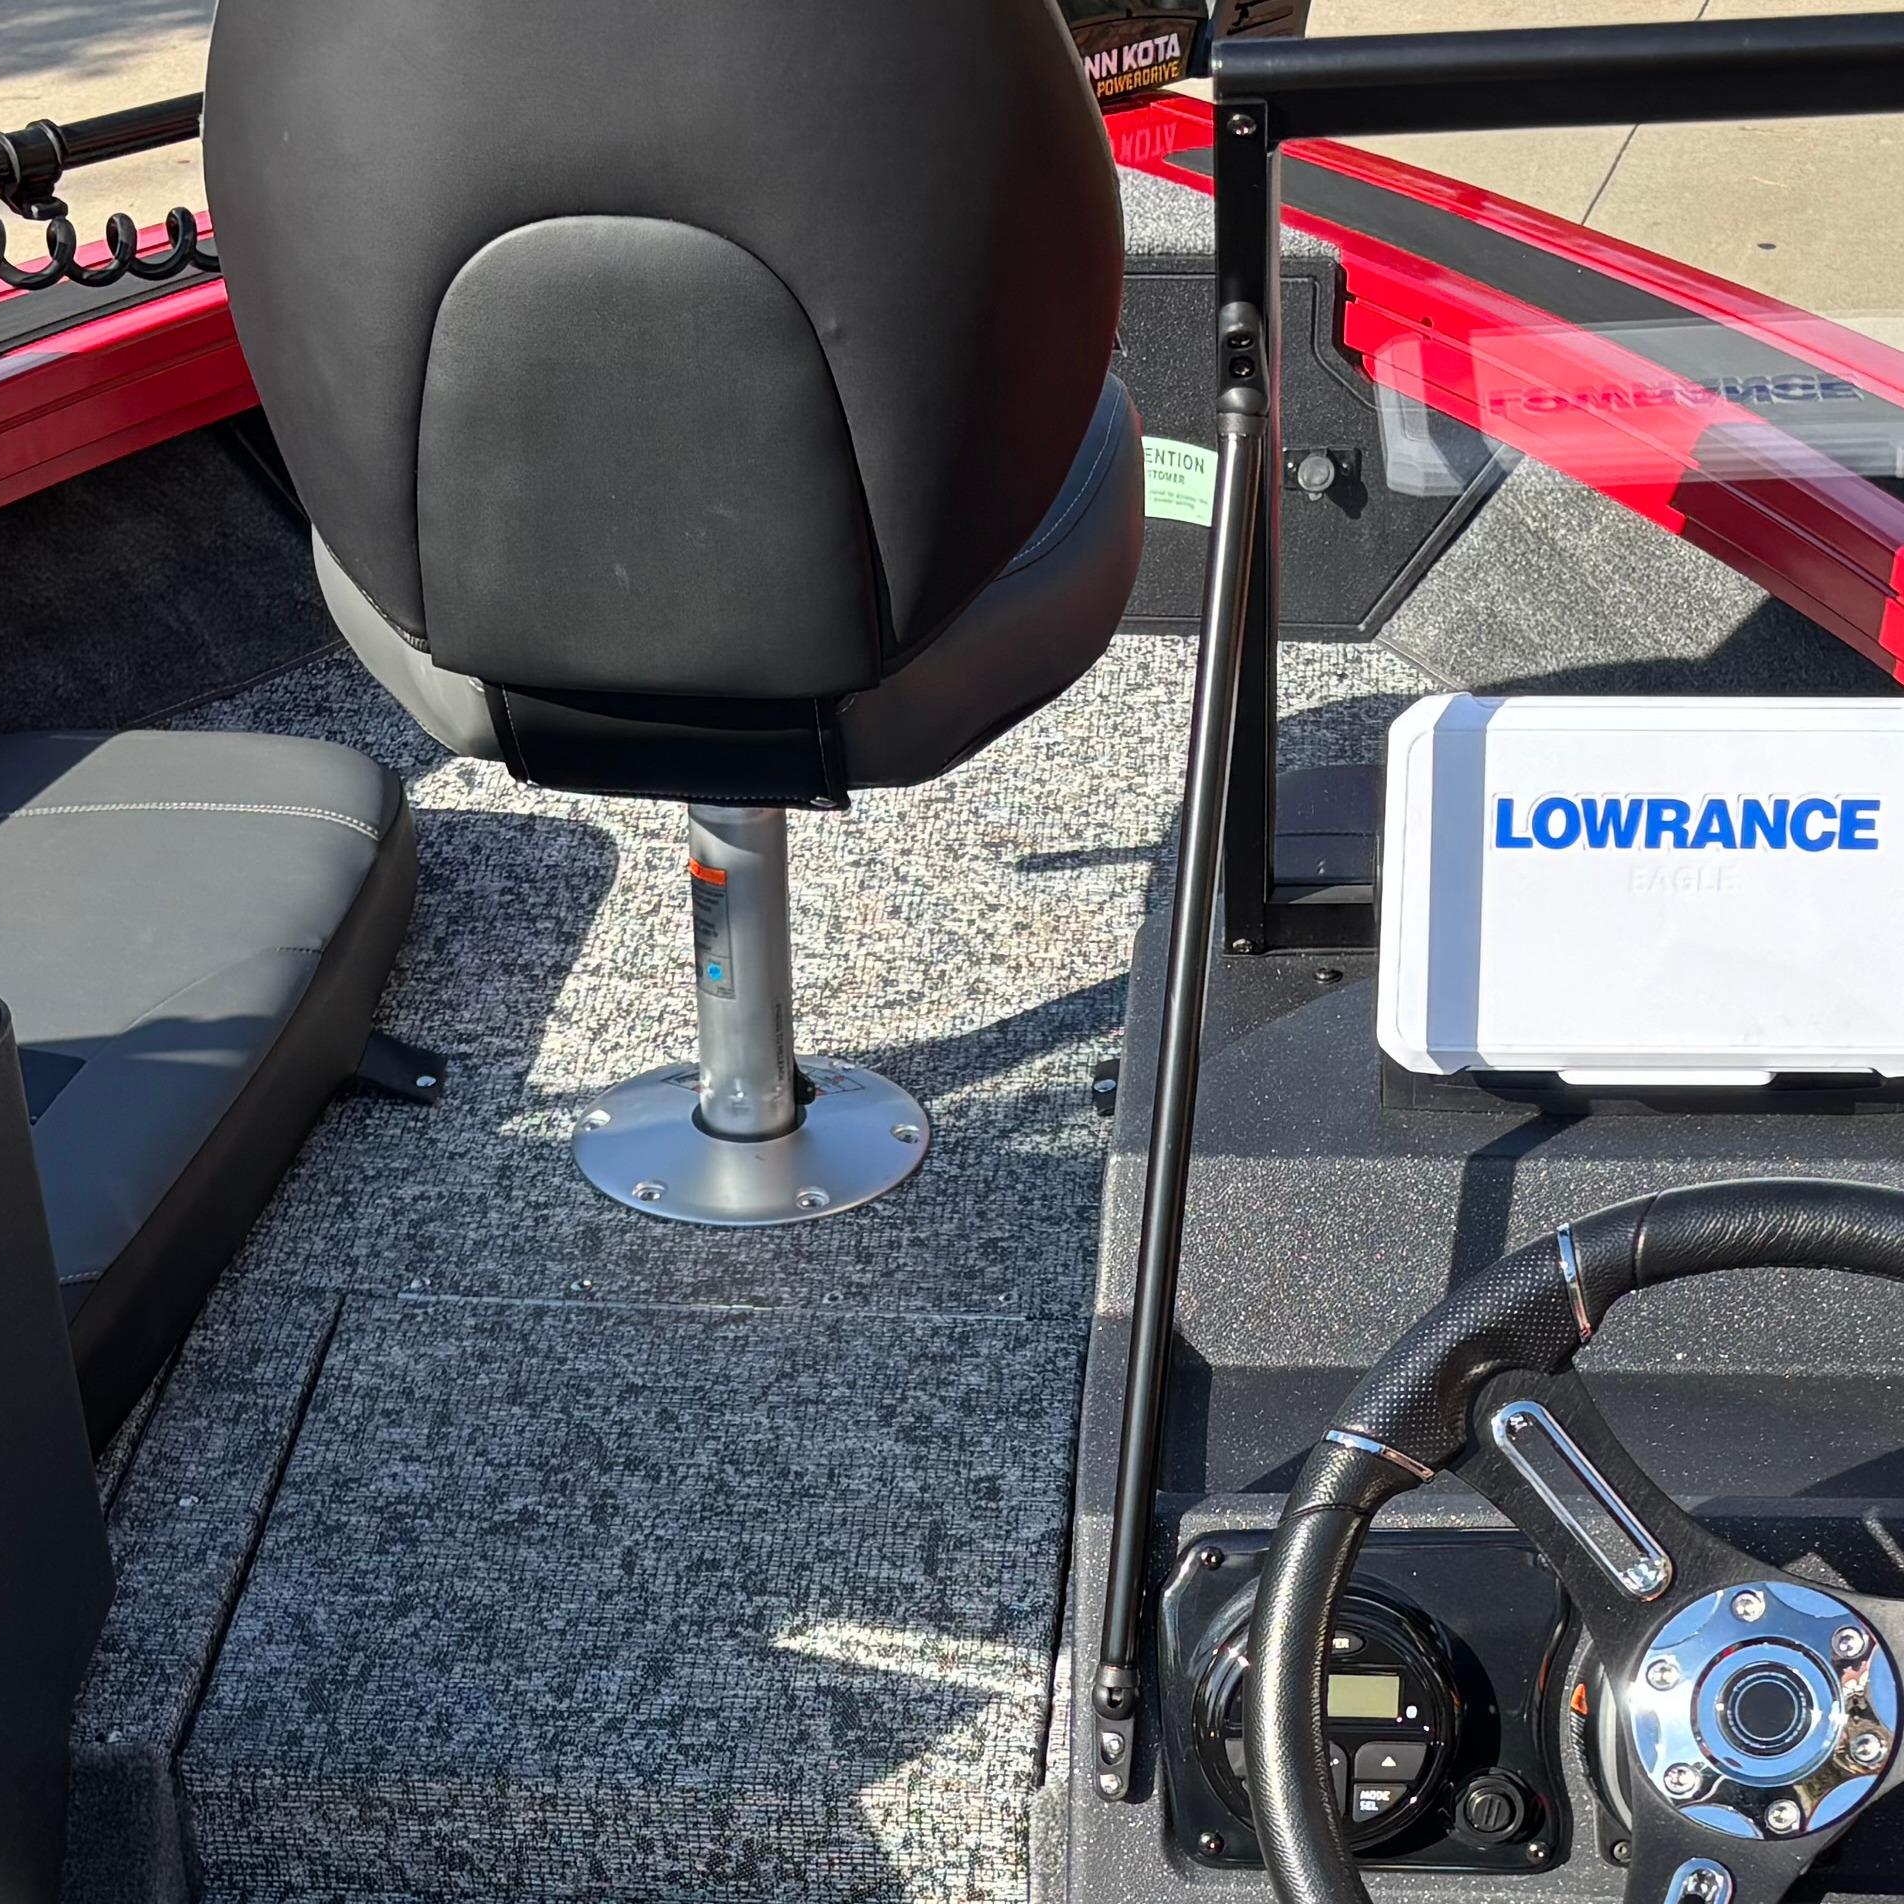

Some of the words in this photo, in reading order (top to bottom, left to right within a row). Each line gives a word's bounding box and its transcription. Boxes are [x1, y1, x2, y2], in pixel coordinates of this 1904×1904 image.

[1084, 48, 1118, 81] NN
[1122, 32, 1181, 72] KOTA
[1096, 60, 1180, 98] POWERDRIVE
[1145, 447, 1205, 474] ENTION
[1149, 470, 1185, 485] TOMER
[1496, 797, 1881, 852] LOWRANCE
[1630, 864, 1741, 895] EAGLE
[1360, 1790, 1391, 1801] MODE
